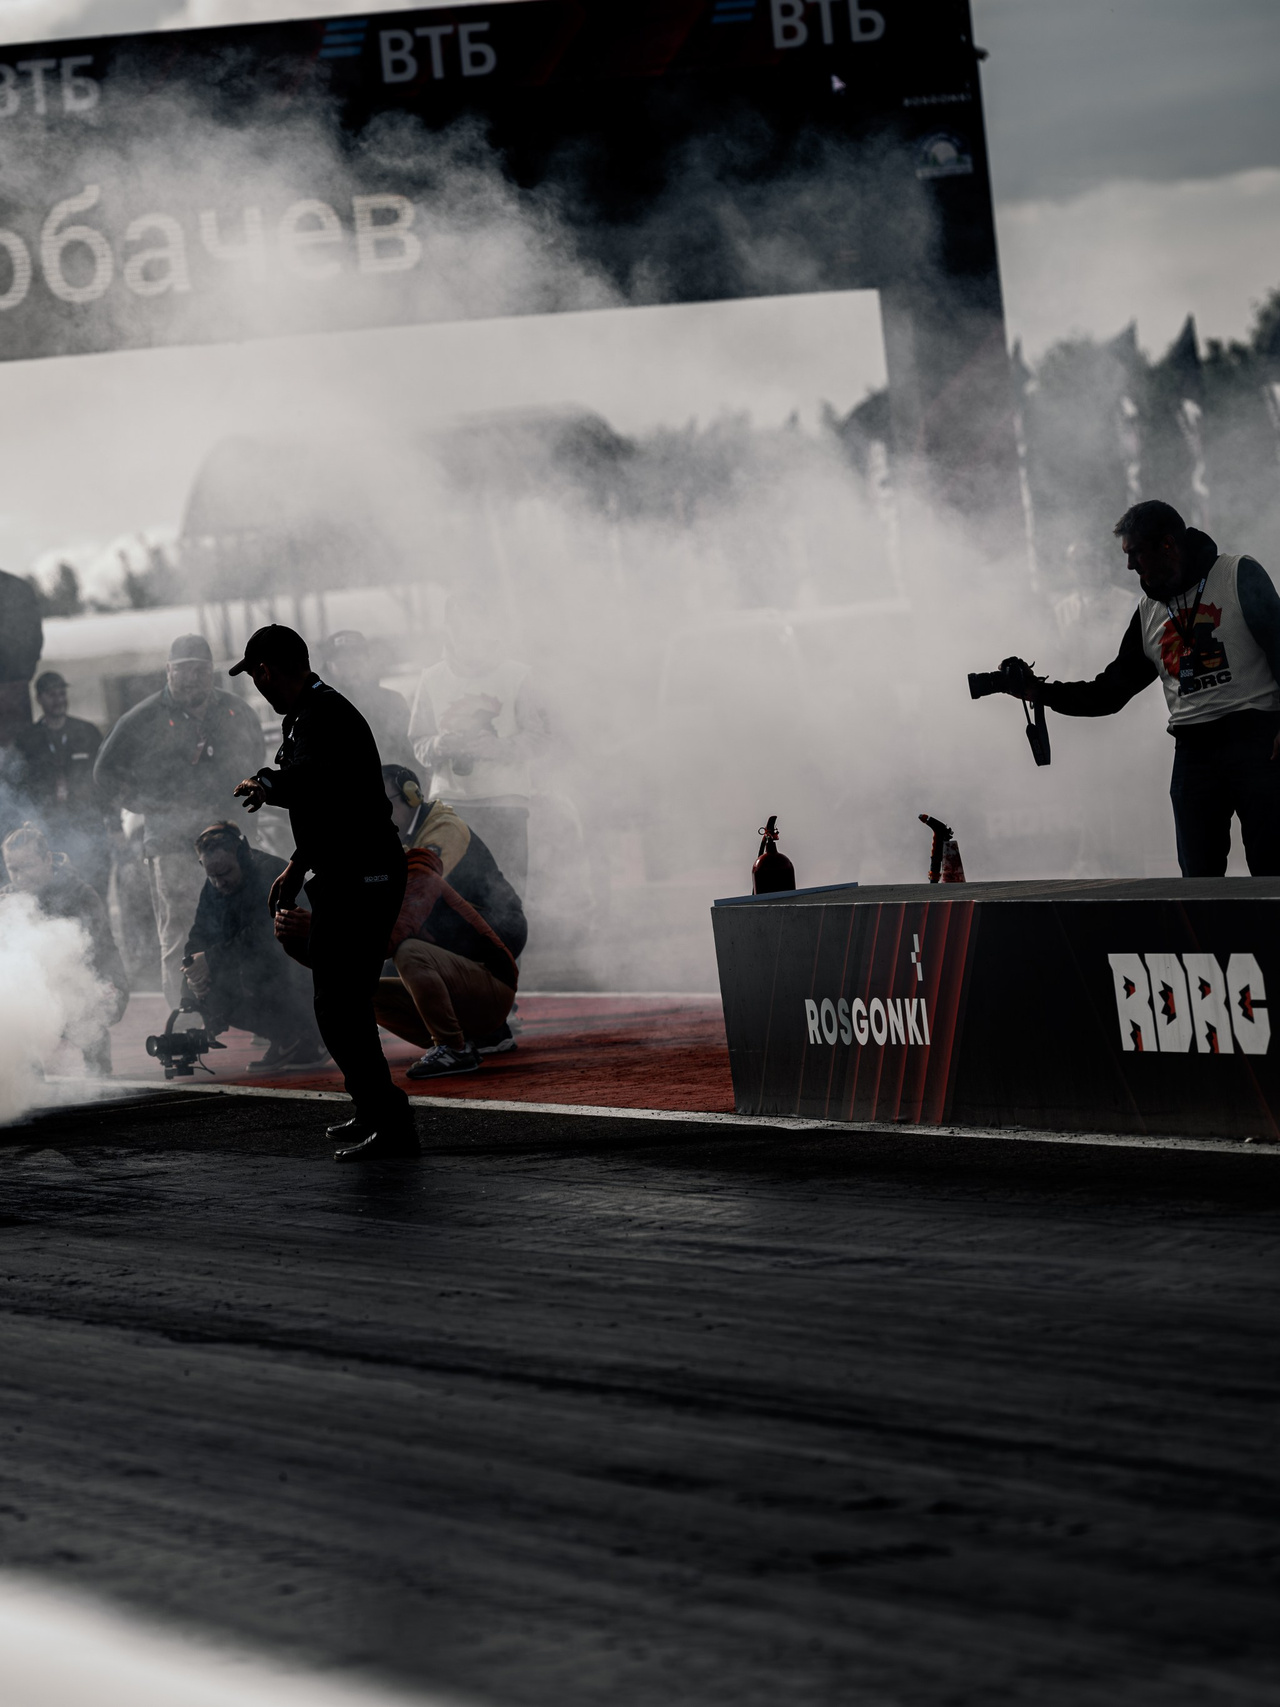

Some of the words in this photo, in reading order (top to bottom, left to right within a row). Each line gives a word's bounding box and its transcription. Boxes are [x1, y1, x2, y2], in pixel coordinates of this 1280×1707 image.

[379, 22, 497, 84] ВТБ
[805, 998, 931, 1046] ROSGONKI
[1108, 953, 1271, 1055] RDRC
